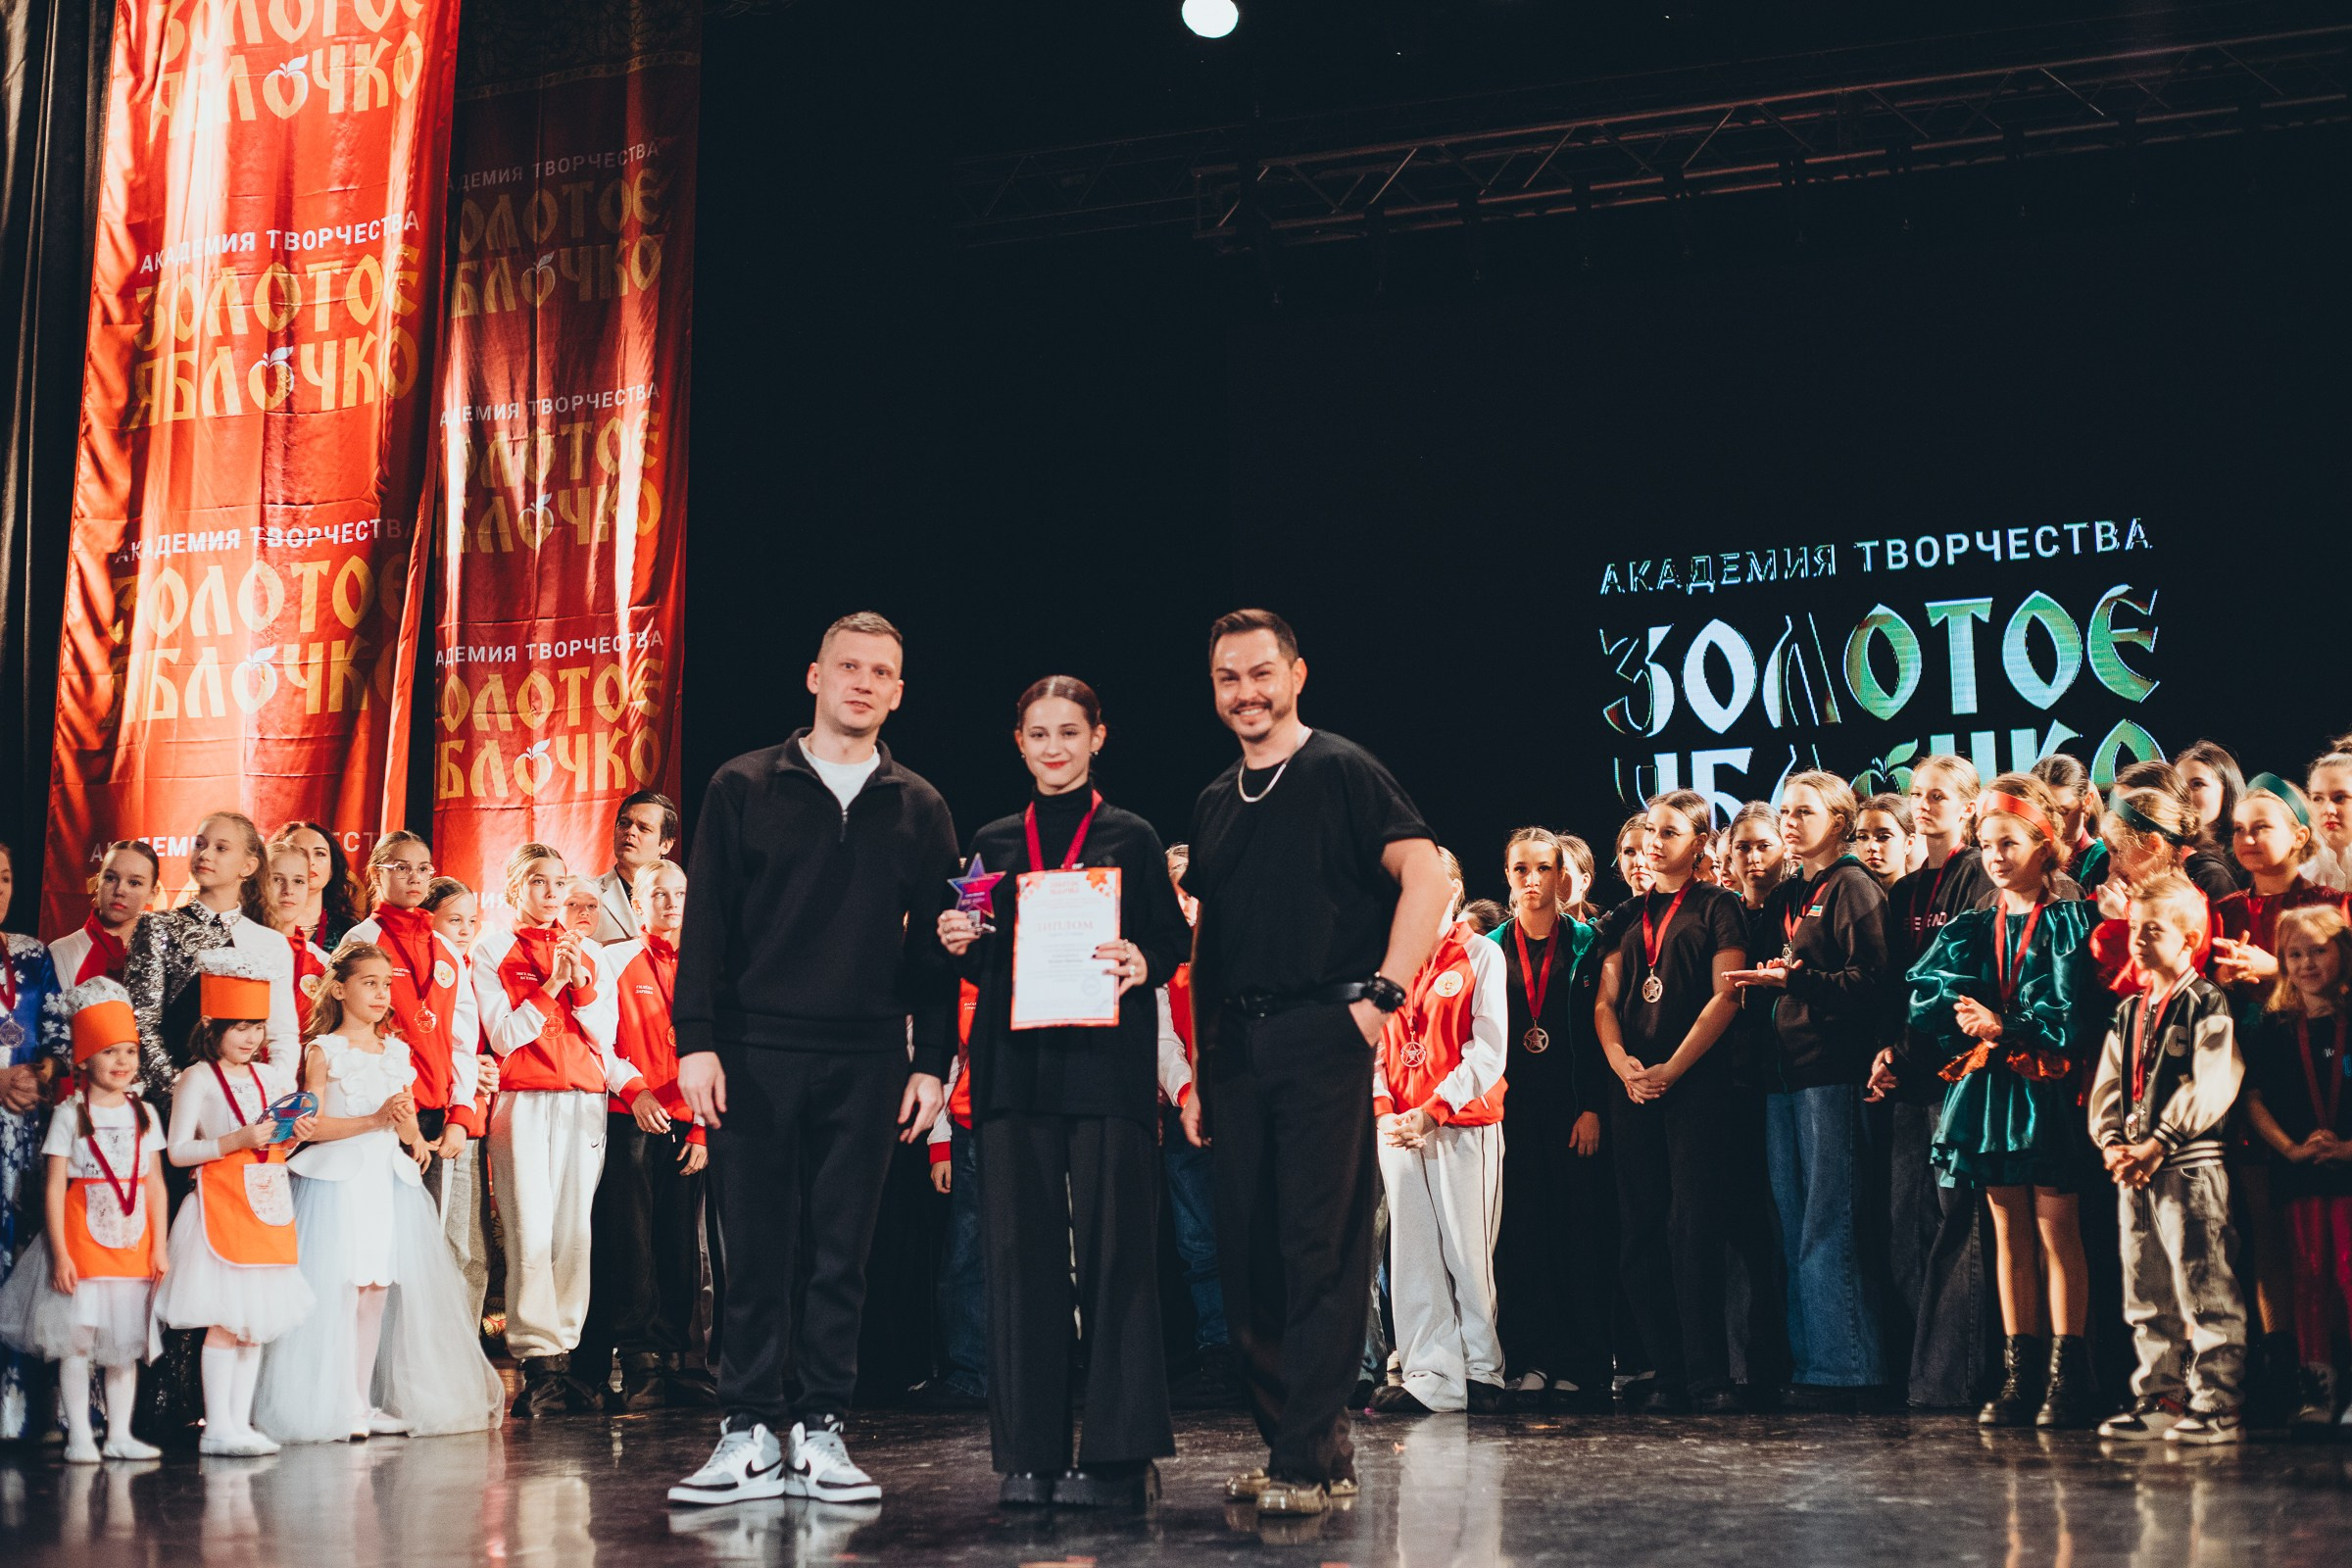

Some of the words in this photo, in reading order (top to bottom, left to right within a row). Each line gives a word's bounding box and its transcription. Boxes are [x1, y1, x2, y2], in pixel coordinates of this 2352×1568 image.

[150, 30, 423, 135] ЯЛОЧКО
[532, 140, 660, 177] ТВОРЧЕСТВА
[139, 231, 256, 274] АКАДЕМИЯ
[266, 210, 419, 251] ТВОРЧЕСТВА
[134, 243, 419, 351] ЗОЛОТОЕ
[128, 325, 418, 429] ЯБЛОЧКО
[528, 382, 660, 416] ТВОРЧЕСТВА
[115, 528, 240, 563] АКАДЕМИЯ
[1600, 543, 1837, 595] АКАДЕМИЯ
[1854, 516, 2154, 572] ТВОРЧЕСТВА
[525, 630, 664, 662] ТВОРЧЕСТВА
[1599, 583, 2161, 738] ЗОЛОТОЕ
